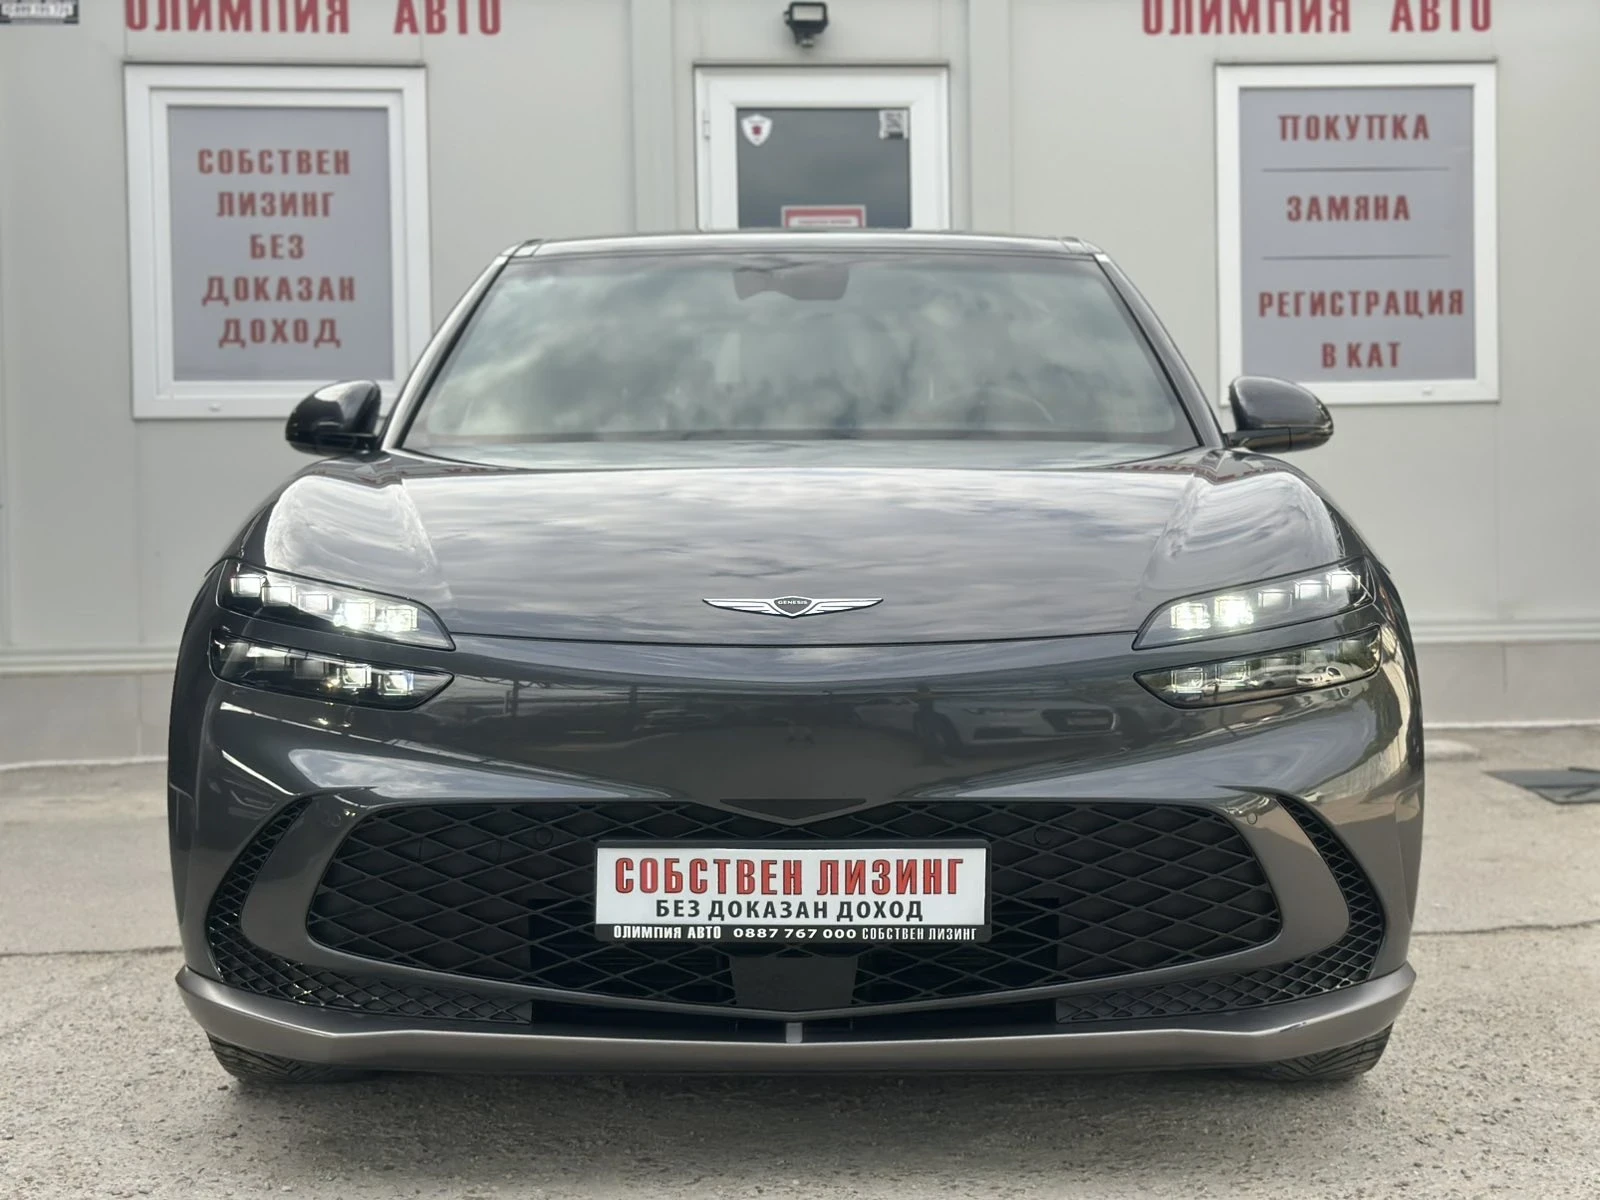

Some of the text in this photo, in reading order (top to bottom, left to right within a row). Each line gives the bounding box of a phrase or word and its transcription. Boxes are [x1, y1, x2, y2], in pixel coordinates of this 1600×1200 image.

[1278, 114, 1430, 142] ПОКУПКА
[197, 149, 351, 176] СОБСТВЕН
[216, 191, 336, 218] ЛИЗИНГ
[1286, 194, 1411, 222] ЗАМЯНА
[249, 234, 305, 260] БЕЗ
[201, 276, 357, 307] ДОКАЗАН
[1258, 289, 1465, 319] РЕГИСТРАЦИЯ
[218, 318, 342, 349] ДОХОД
[1321, 342, 1402, 369] В КАТ
[614, 857, 964, 896] СОБСТВЕН ЛИЗИНГ
[655, 899, 924, 922] БЕЗ ДОКАЗАН ДОХОД
[613, 925, 977, 941] ОЛИМПИЯ АВТО 0887 767 000 СОБСТВЕН ЛИЗИНГ
